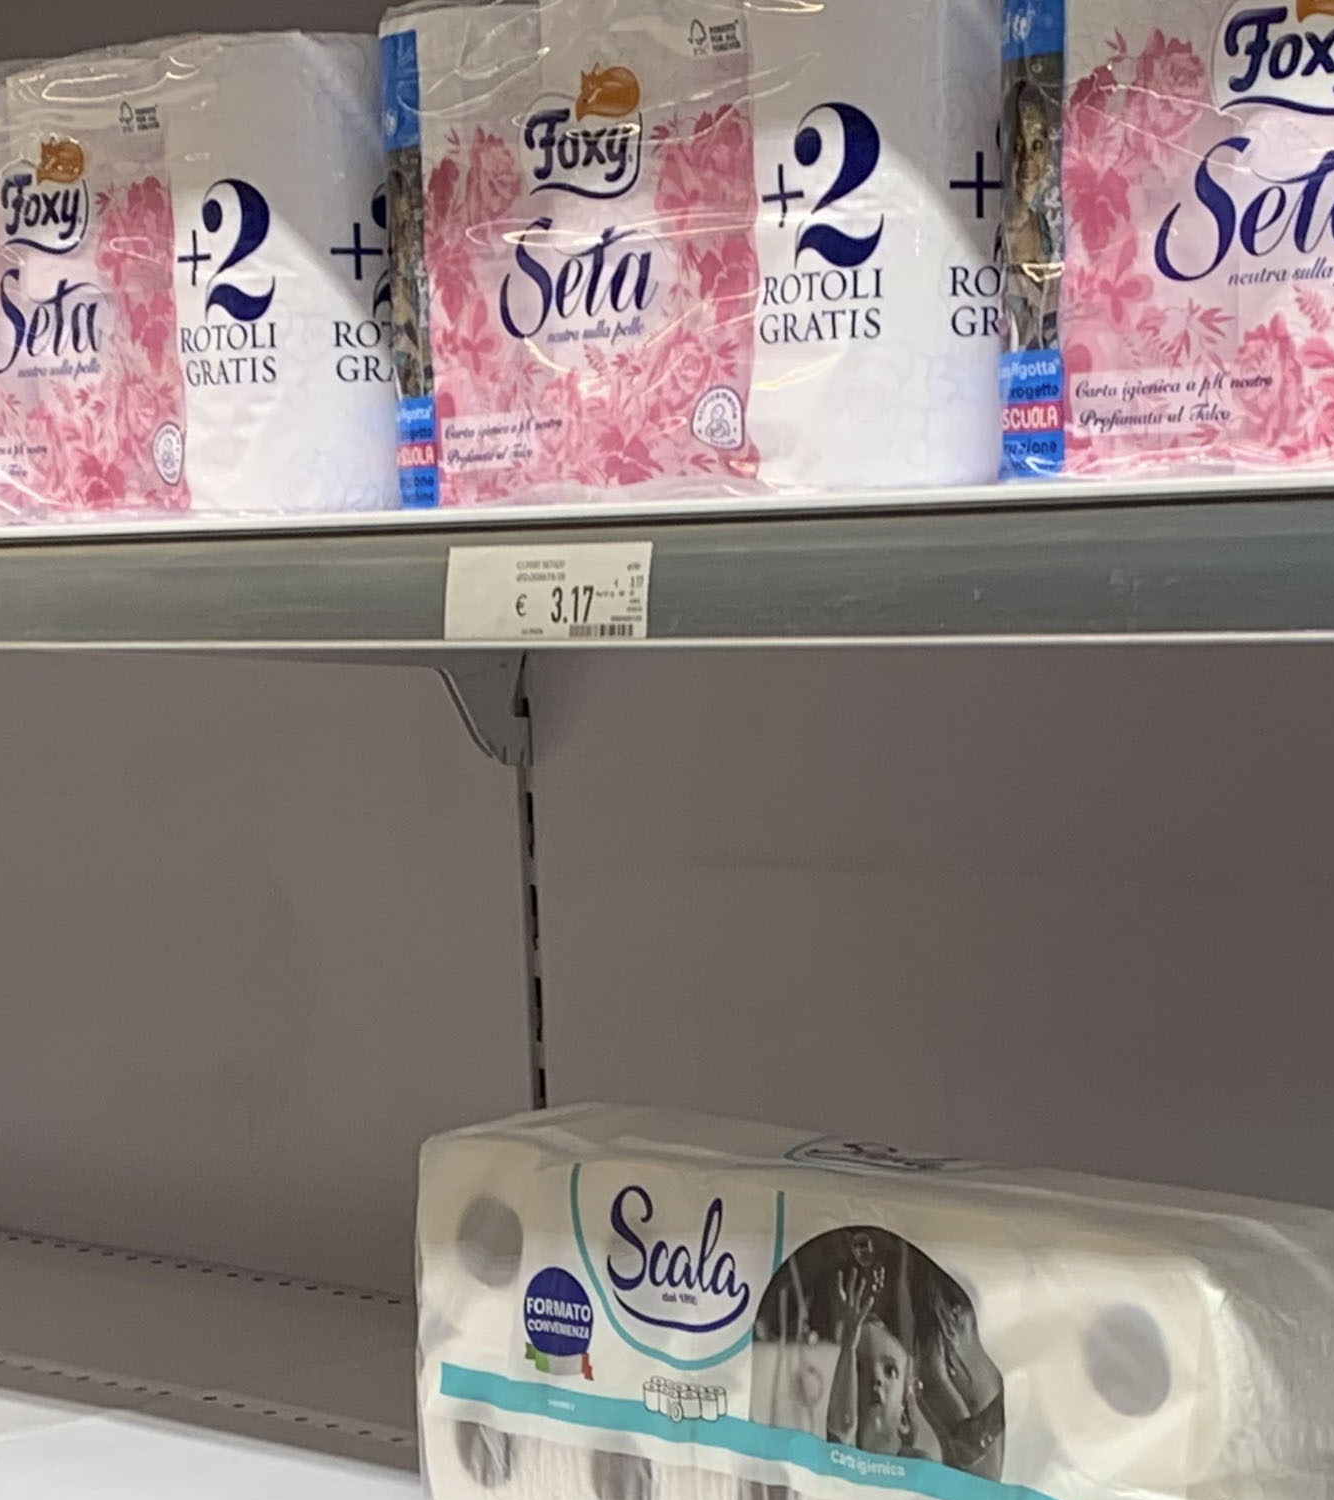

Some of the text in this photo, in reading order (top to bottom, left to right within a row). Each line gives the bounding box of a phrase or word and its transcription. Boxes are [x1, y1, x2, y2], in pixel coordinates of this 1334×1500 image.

[524, 108, 631, 183] Foxy
[762, 102, 884, 268] +2
[0, 174, 80, 240] Foxy
[178, 178, 275, 321] +2
[500, 217, 661, 339] Seta
[763, 268, 884, 305] ROTOLI
[1228, 265, 1287, 286] neutra
[1291, 257, 1333, 281] sulla
[180, 323, 276, 353] ROTOLI
[760, 308, 881, 344] GRATIS
[186, 356, 276, 387] GRATIS
[1186, 382, 1195, 392] a
[1002, 405, 1058, 430] SCUOLA
[516, 594, 527, 616] €
[551, 586, 594, 624] 3.17
[606, 1185, 750, 1298] Scala
[526, 1297, 591, 1322] FORMATO
